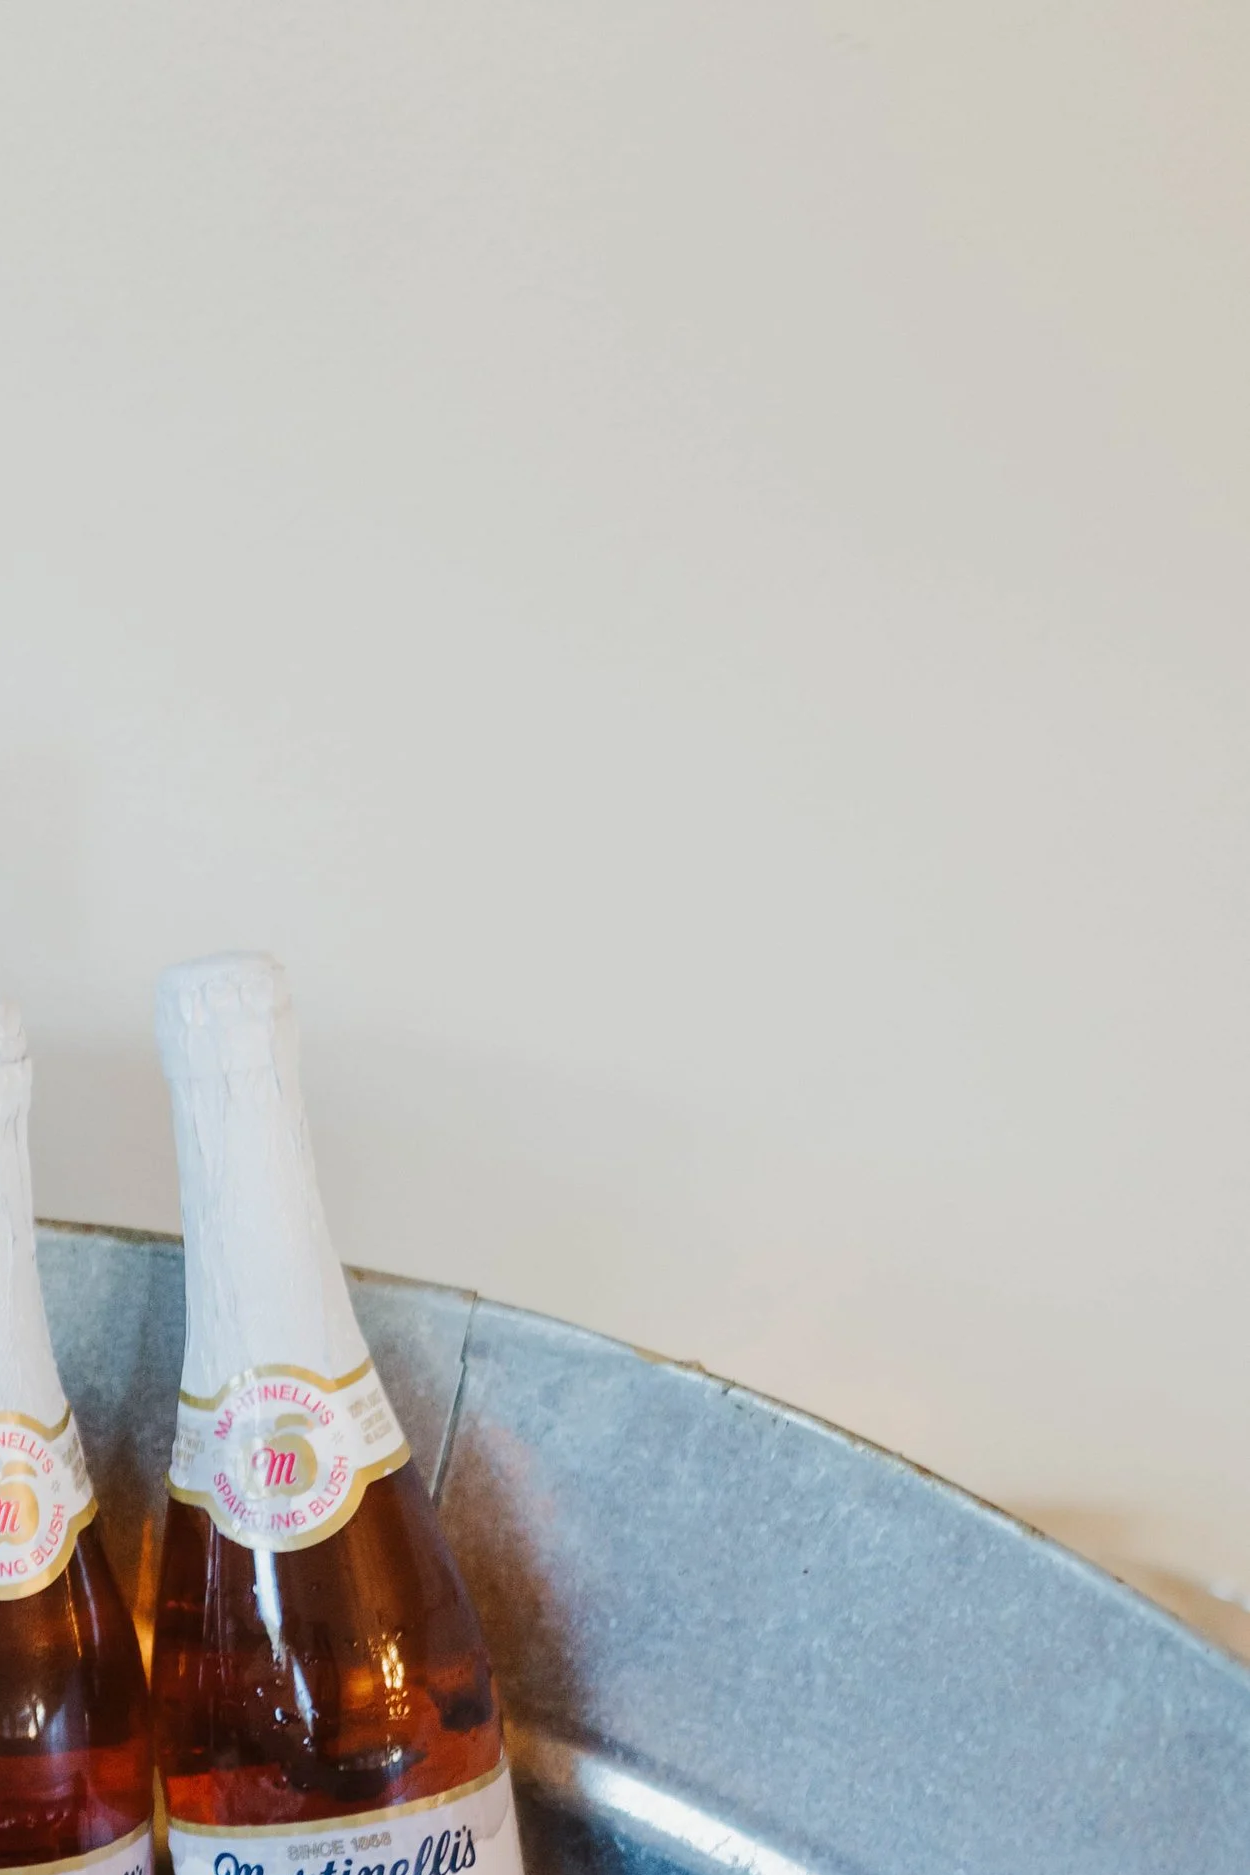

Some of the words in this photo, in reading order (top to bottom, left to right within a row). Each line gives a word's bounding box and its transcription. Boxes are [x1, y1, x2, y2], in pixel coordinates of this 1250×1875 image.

[308, 1456, 349, 1517] BLUSH
[30, 1504, 65, 1566] BLUSH
[287, 1841, 345, 1861] SINCE
[351, 1831, 393, 1852] 1868
